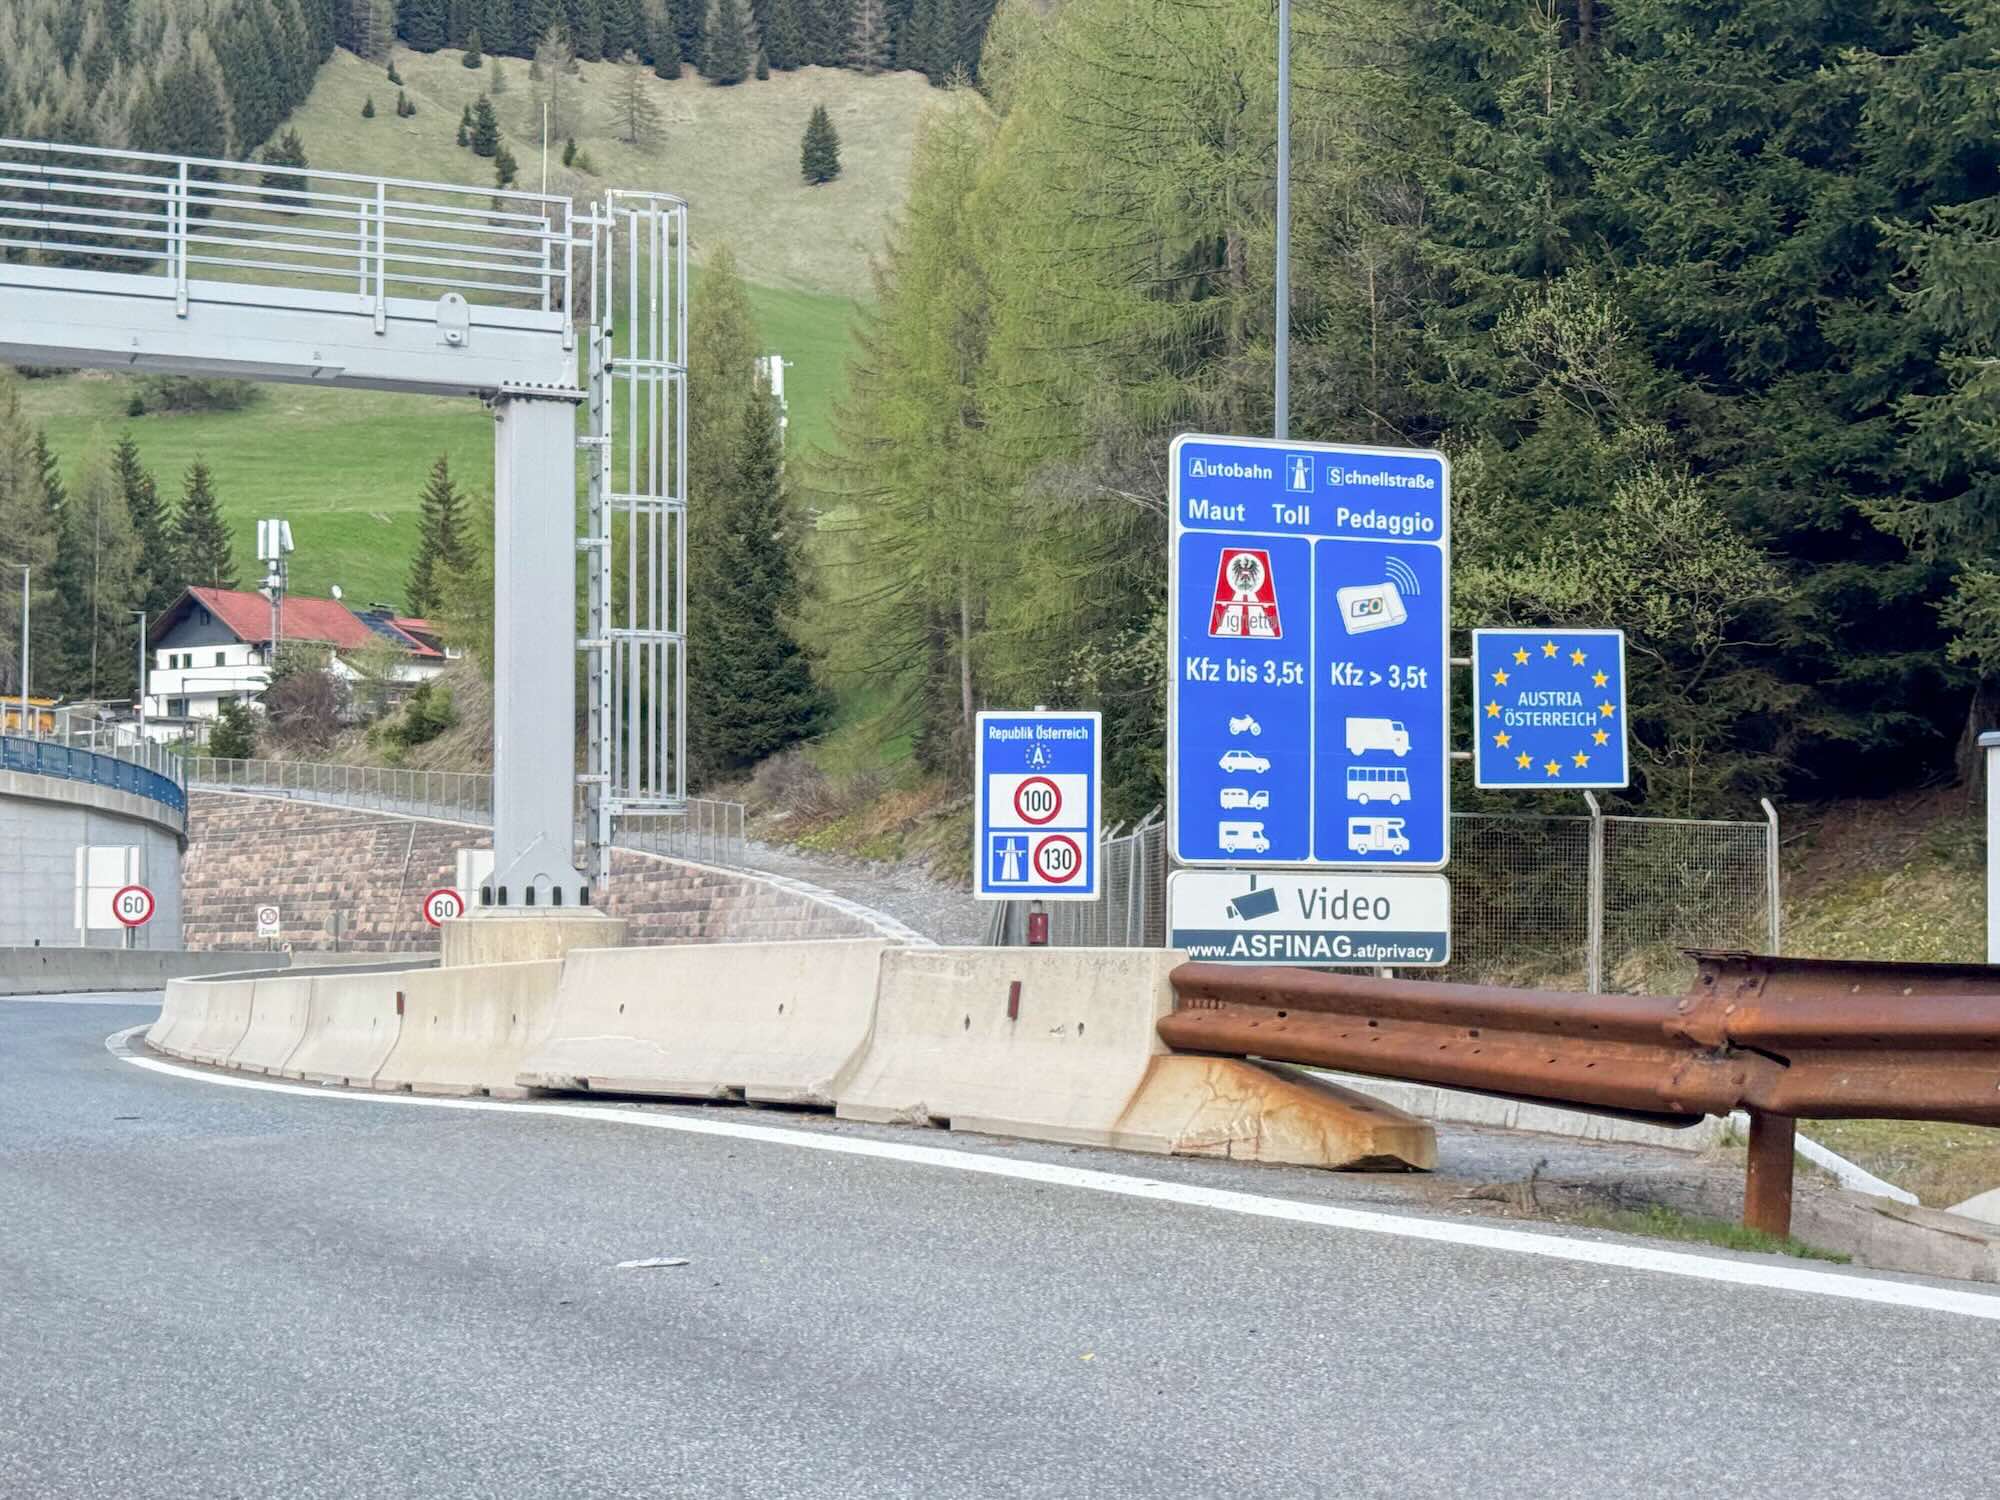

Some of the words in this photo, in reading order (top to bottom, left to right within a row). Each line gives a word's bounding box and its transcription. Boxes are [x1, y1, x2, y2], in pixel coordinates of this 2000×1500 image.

[1192, 460, 1272, 480] Autobahn
[1329, 467, 1435, 489] Schnellstraße
[1188, 498, 1246, 522] Maut
[1271, 503, 1310, 525] Toll
[1336, 506, 1434, 535] Pedaggio
[1356, 598, 1382, 615] GO
[1186, 656, 1220, 681] Kfz
[1226, 658, 1257, 683] bis
[1263, 660, 1304, 687] 3,5t
[1331, 661, 1364, 686] Kfz
[1388, 664, 1428, 692] 3,5t
[1518, 691, 1583, 706] AUSTRIA
[1504, 708, 1597, 726] ÖSTERREICH
[989, 725, 1034, 743] Republik
[1035, 724, 1089, 740] Österreich
[1032, 747, 1045, 764] A
[1024, 790, 1052, 812] 100
[1044, 848, 1072, 870] 130
[124, 896, 144, 914] 60
[434, 900, 454, 918] 60
[1298, 886, 1391, 921] Video
[1187, 934, 1434, 962] www.ASFINAG.at/privacy
